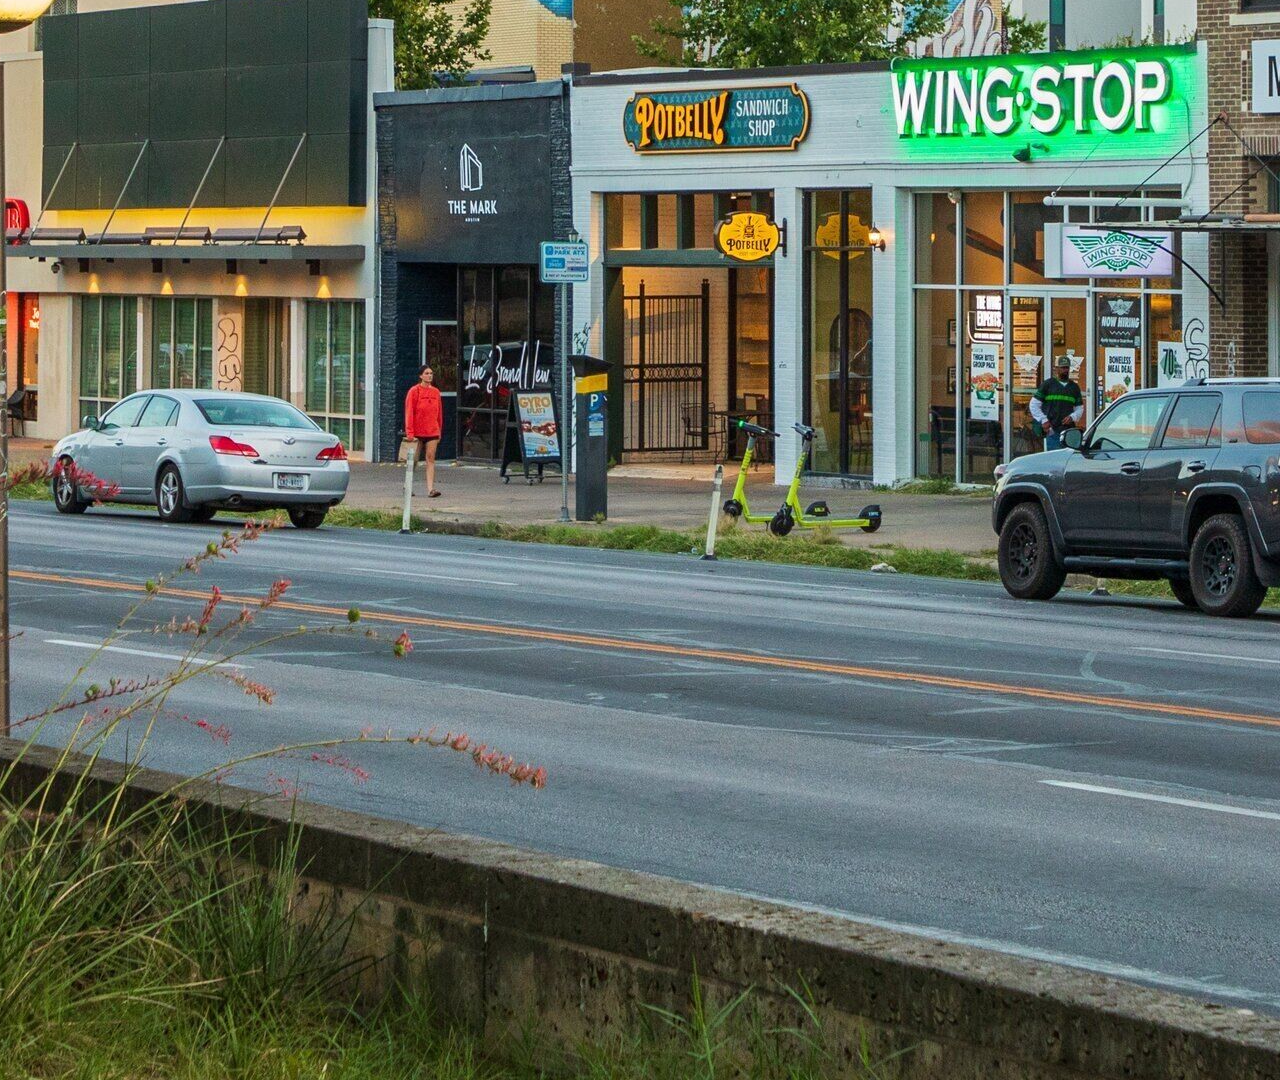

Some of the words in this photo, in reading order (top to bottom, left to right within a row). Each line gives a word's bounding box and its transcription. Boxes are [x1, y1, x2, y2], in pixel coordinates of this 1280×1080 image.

[635, 90, 729, 148] POTBELLY
[736, 99, 789, 117] SANDWICH
[748, 119, 776, 137] SHOP
[448, 200, 467, 214] THE
[470, 200, 498, 214] MARK
[727, 237, 772, 253] POTBELLY
[1101, 316, 1116, 327] NOW
[1117, 316, 1140, 328] HIRING
[973, 361, 986, 369] GROUP
[1109, 356, 1132, 365] BONELESS
[465, 345, 487, 390] Live
[486, 341, 527, 394] Brand
[1107, 365, 1120, 374] MEAL
[1121, 365, 1133, 374] DEAL
[519, 396, 551, 409] GYRO
